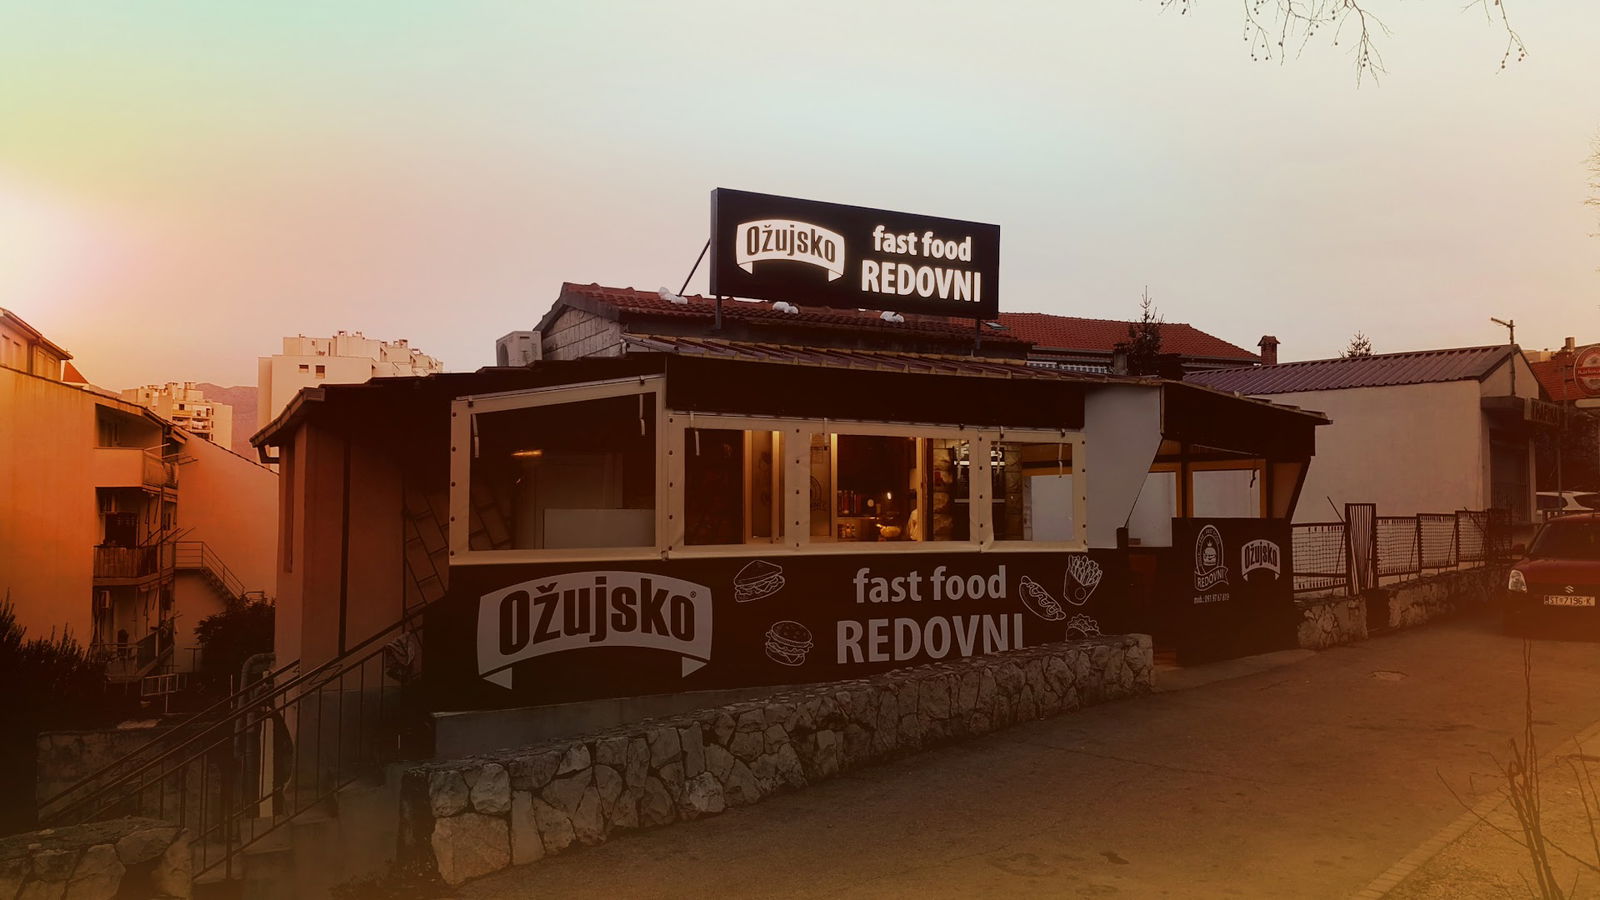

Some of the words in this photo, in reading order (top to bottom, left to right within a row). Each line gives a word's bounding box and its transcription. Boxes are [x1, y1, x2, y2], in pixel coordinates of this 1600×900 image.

[746, 223, 836, 264] Ožujsko
[873, 225, 918, 256] fast
[922, 231, 972, 262] food
[861, 260, 982, 302] REDOVNI
[1244, 541, 1278, 569] Ožujsko
[853, 567, 923, 604] fast
[929, 564, 1007, 602] food
[1197, 569, 1224, 588] REDOVNI
[499, 576, 695, 655] Ožujsko
[836, 613, 1024, 665] REDOVNI
